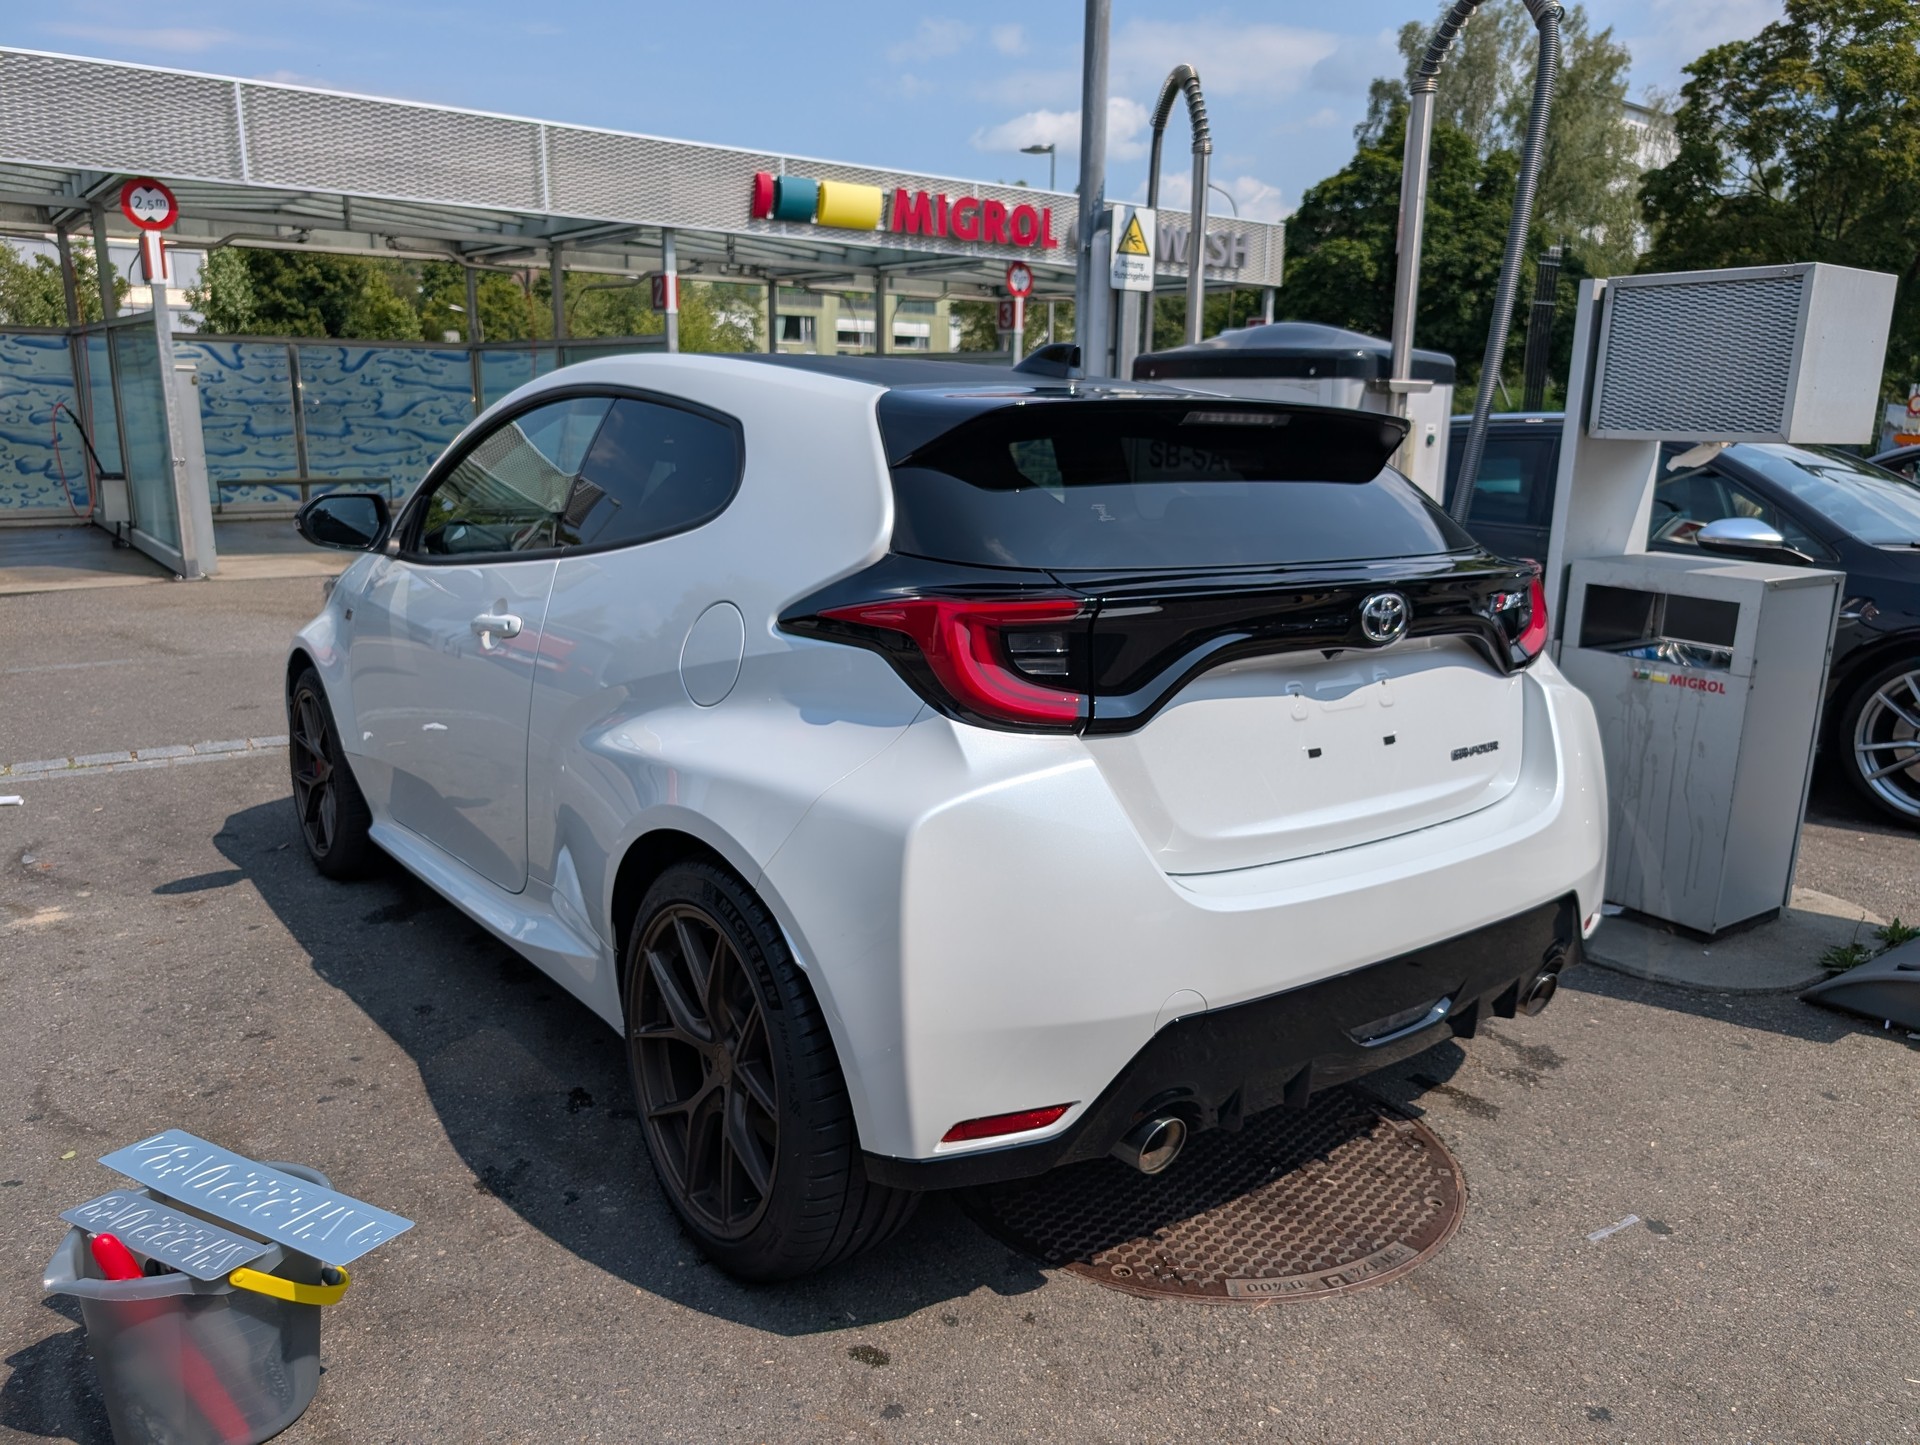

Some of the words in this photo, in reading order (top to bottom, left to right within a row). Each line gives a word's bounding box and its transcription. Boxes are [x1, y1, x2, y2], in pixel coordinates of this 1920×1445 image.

[889, 187, 1058, 250] MIGROL
[1158, 223, 1250, 269] WSH
[1000, 303, 1013, 328] 3
[1669, 674, 1726, 694] MIGROL
[719, 897, 779, 1005] MICHELIN
